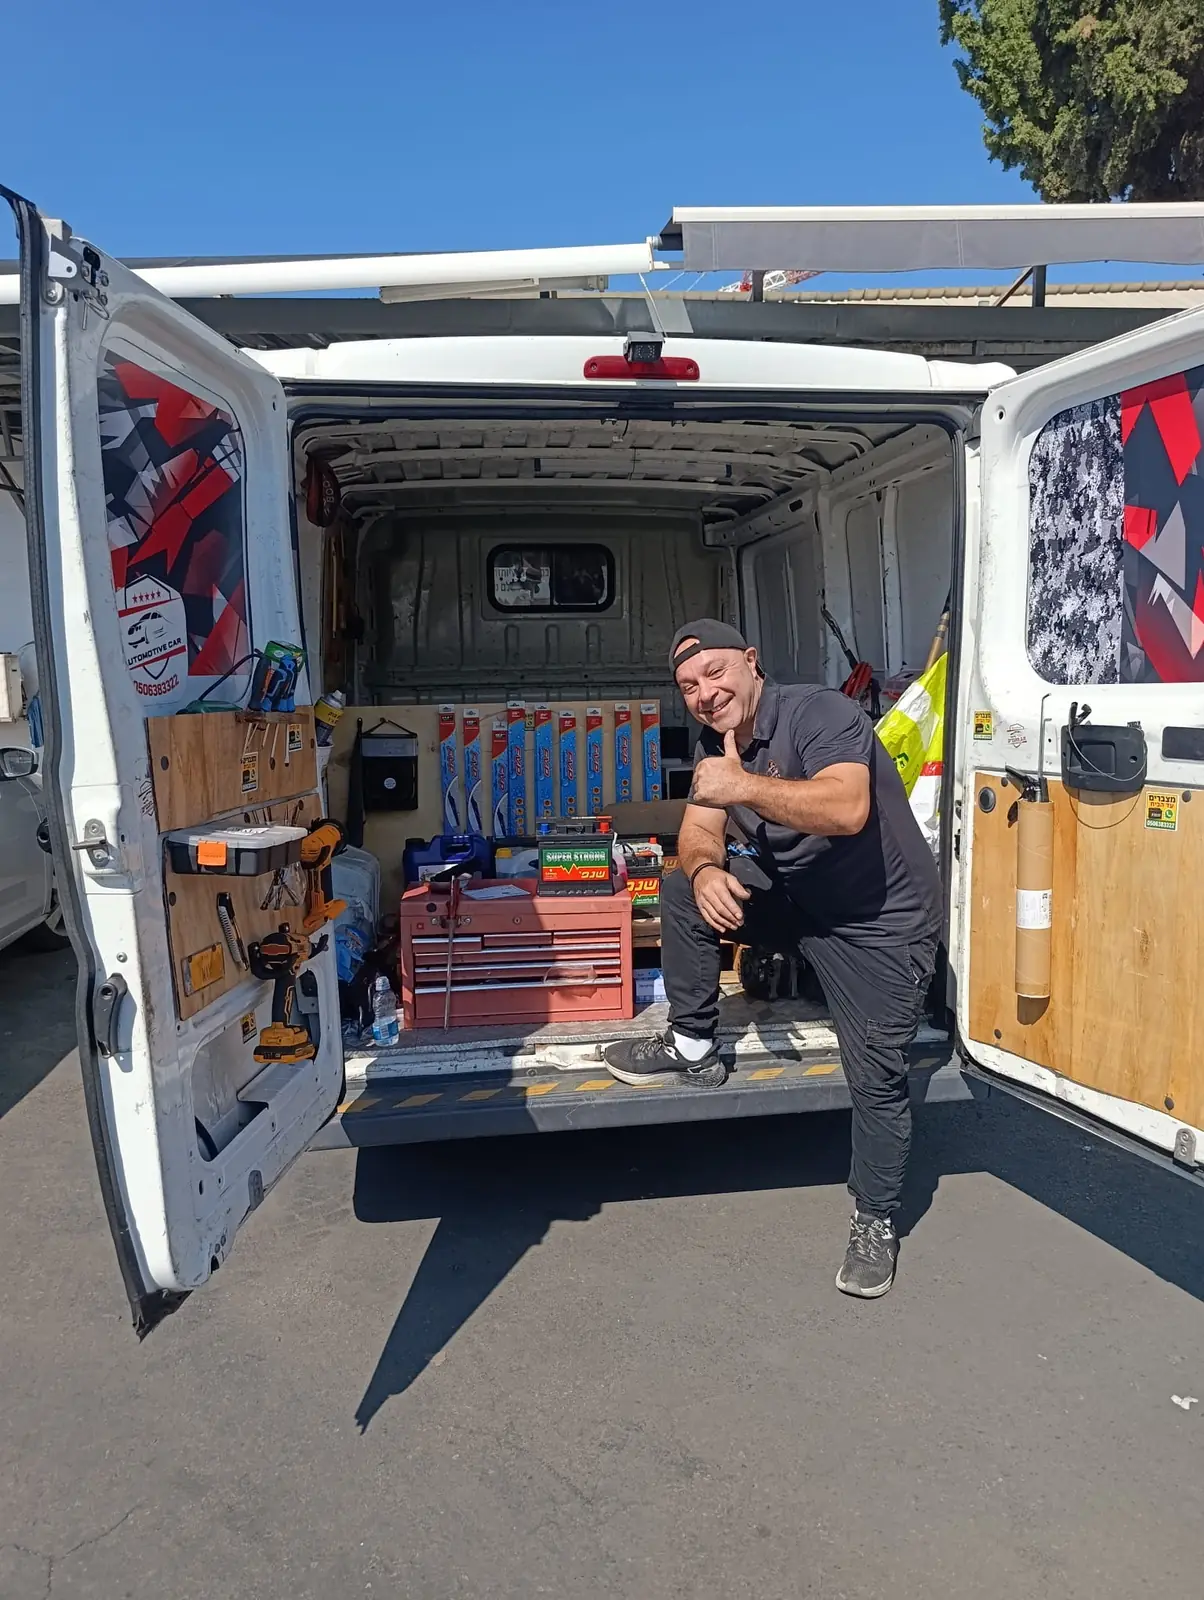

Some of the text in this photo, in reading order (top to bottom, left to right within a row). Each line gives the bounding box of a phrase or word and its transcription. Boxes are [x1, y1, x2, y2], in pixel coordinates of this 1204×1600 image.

[127, 637, 182, 666] UTOMOTIVE CAR
[1148, 795, 1176, 803] מצברים
[546, 851, 606, 862] SUPER STRONG
